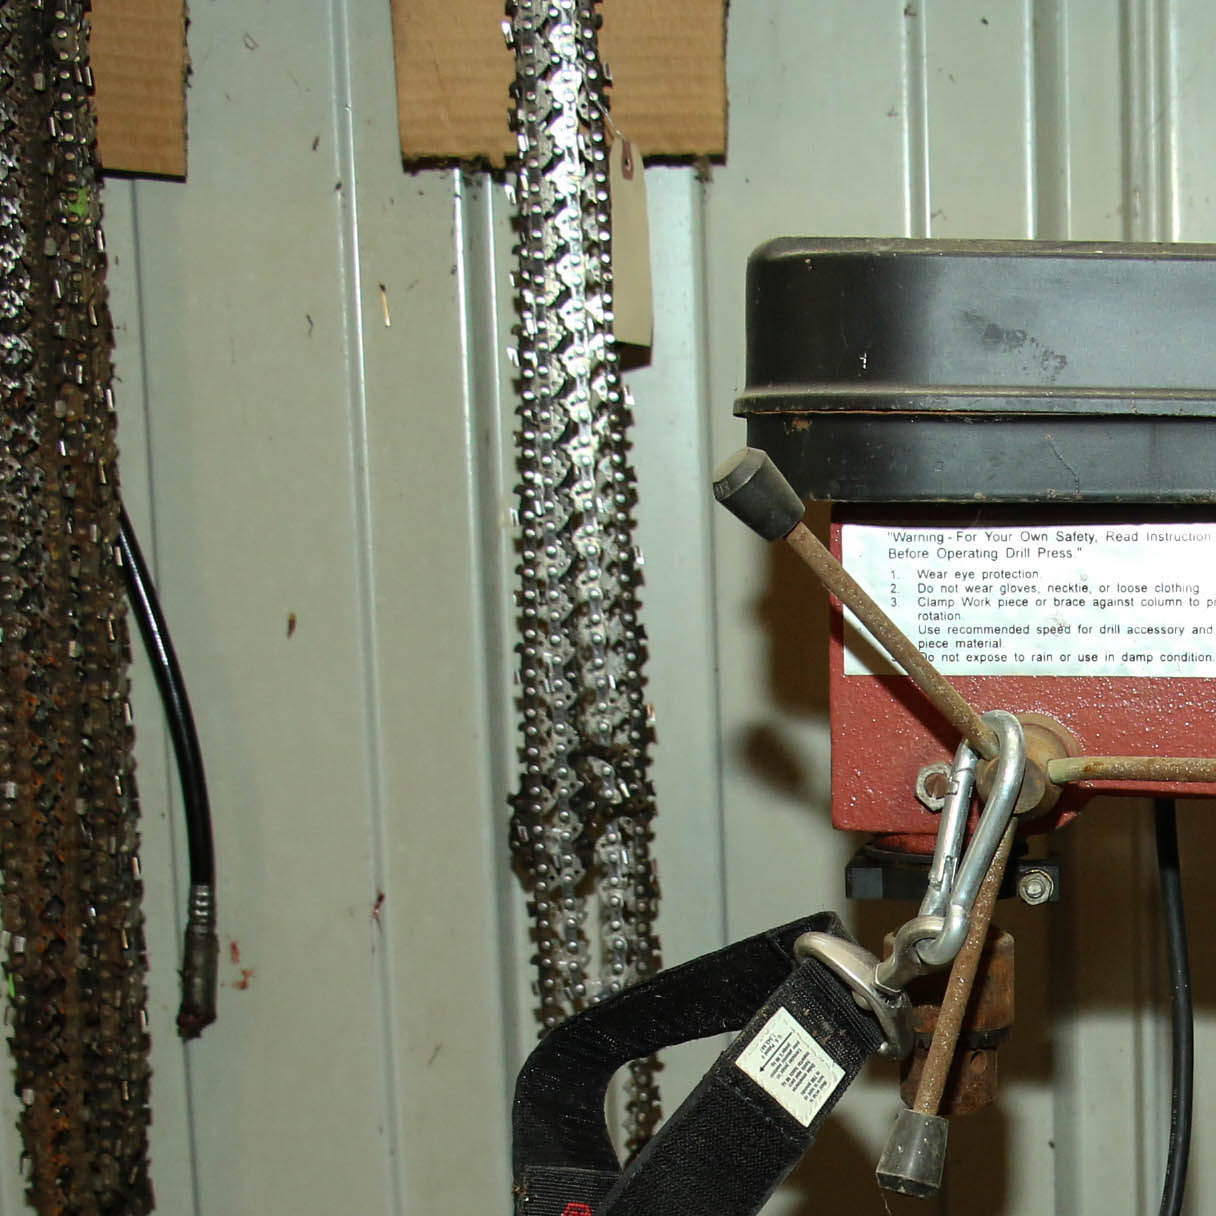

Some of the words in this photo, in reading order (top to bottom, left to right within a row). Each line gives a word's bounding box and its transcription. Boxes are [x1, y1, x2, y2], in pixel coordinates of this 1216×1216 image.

[956, 531, 977, 543] For
[985, 531, 1012, 543] Your
[1020, 531, 1048, 543] Own
[1056, 531, 1099, 544] Safety,
[1106, 531, 1138, 543] Read
[1147, 531, 1211, 543] Instruction
[888, 548, 930, 559] Before
[937, 548, 998, 561] Operating
[1006, 547, 1030, 559] Drill
[917, 569, 948, 580] Wear
[954, 571, 975, 581] eye
[917, 583, 934, 594] Do
[940, 583, 959, 594] not
[965, 584, 993, 594] wear
[1000, 583, 1040, 596] gloves,
[1048, 583, 1092, 595] necktie,
[1099, 585, 1110, 594] or
[1117, 583, 1148, 594] loose
[917, 597, 955, 609] Clamp
[961, 597, 991, 608] Work
[998, 597, 1029, 609] piece
[1035, 599, 1047, 608] or
[1053, 597, 1086, 608] brace
[1092, 597, 1134, 610] against
[1141, 597, 1182, 608] column
[1189, 597, 1200, 608] to
[918, 625, 941, 635] Use
[947, 624, 1030, 635] recommended
[1036, 624, 1071, 636] speed
[1078, 624, 1093, 635] for
[1099, 624, 1120, 635] drill
[1126, 624, 1185, 636] accessory
[1192, 624, 1213, 635] and
[918, 638, 949, 650] piece
[941, 652, 960, 662] not
[966, 653, 1008, 664] expose
[1014, 652, 1025, 662] to
[1031, 652, 1053, 662] rain
[1059, 653, 1071, 662] or
[1078, 653, 1099, 662] use
[1105, 652, 1115, 662] in
[1120, 652, 1153, 664] damp
